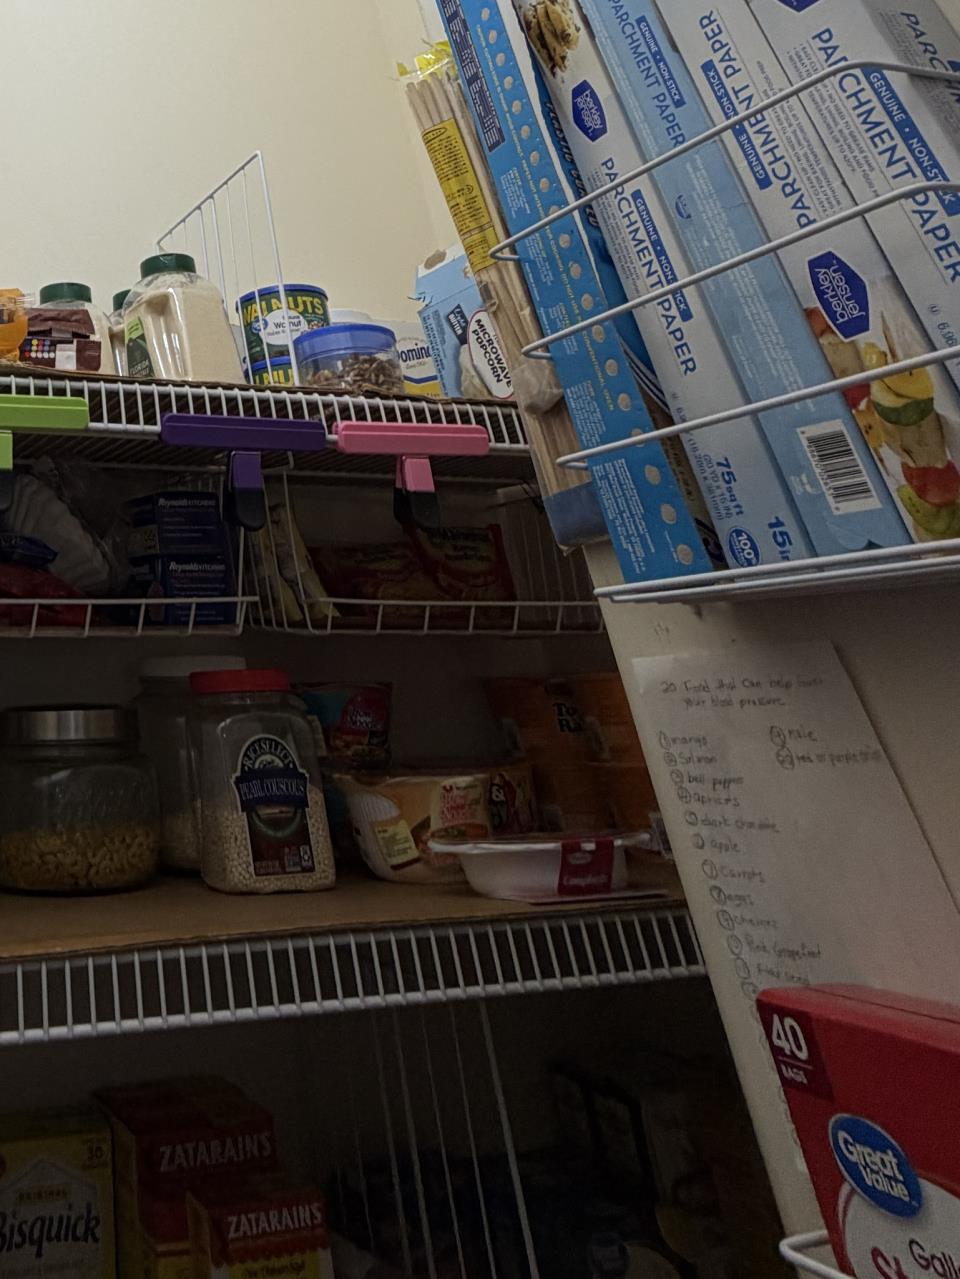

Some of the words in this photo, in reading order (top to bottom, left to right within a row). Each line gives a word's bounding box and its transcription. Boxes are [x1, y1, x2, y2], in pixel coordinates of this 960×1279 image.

[639, 22, 658, 53] GENUINE
[699, 11, 740, 78] PAPER
[582, 90, 603, 130] berkley
[708, 70, 736, 119] NON-STICK
[652, 95, 686, 147] PAPER
[871, 73, 906, 122] GENUINE
[909, 138, 955, 205] NON-SK
[732, 85, 816, 228] PARCHMENT
[740, 134, 766, 179] GENUINE
[602, 157, 663, 289] PARCHMENT
[658, 299, 697, 375] PAPER
[636, 199, 658, 241] GENUINE
[660, 256, 686, 311] NON-TICK
[811, 264, 850, 324] berkley
[828, 261, 865, 320] jensen
[273, 320, 302, 329] Wanut
[399, 342, 431, 363] omin
[472, 327, 504, 384] POPCORN
[475, 319, 512, 388] MICROWAVE
[264, 778, 305, 797] COUSCOUS
[772, 1013, 808, 1061] 40
[837, 1131, 905, 1183] Great
[860, 1167, 910, 1203] Value
[909, 1238, 960, 1279] Gall
